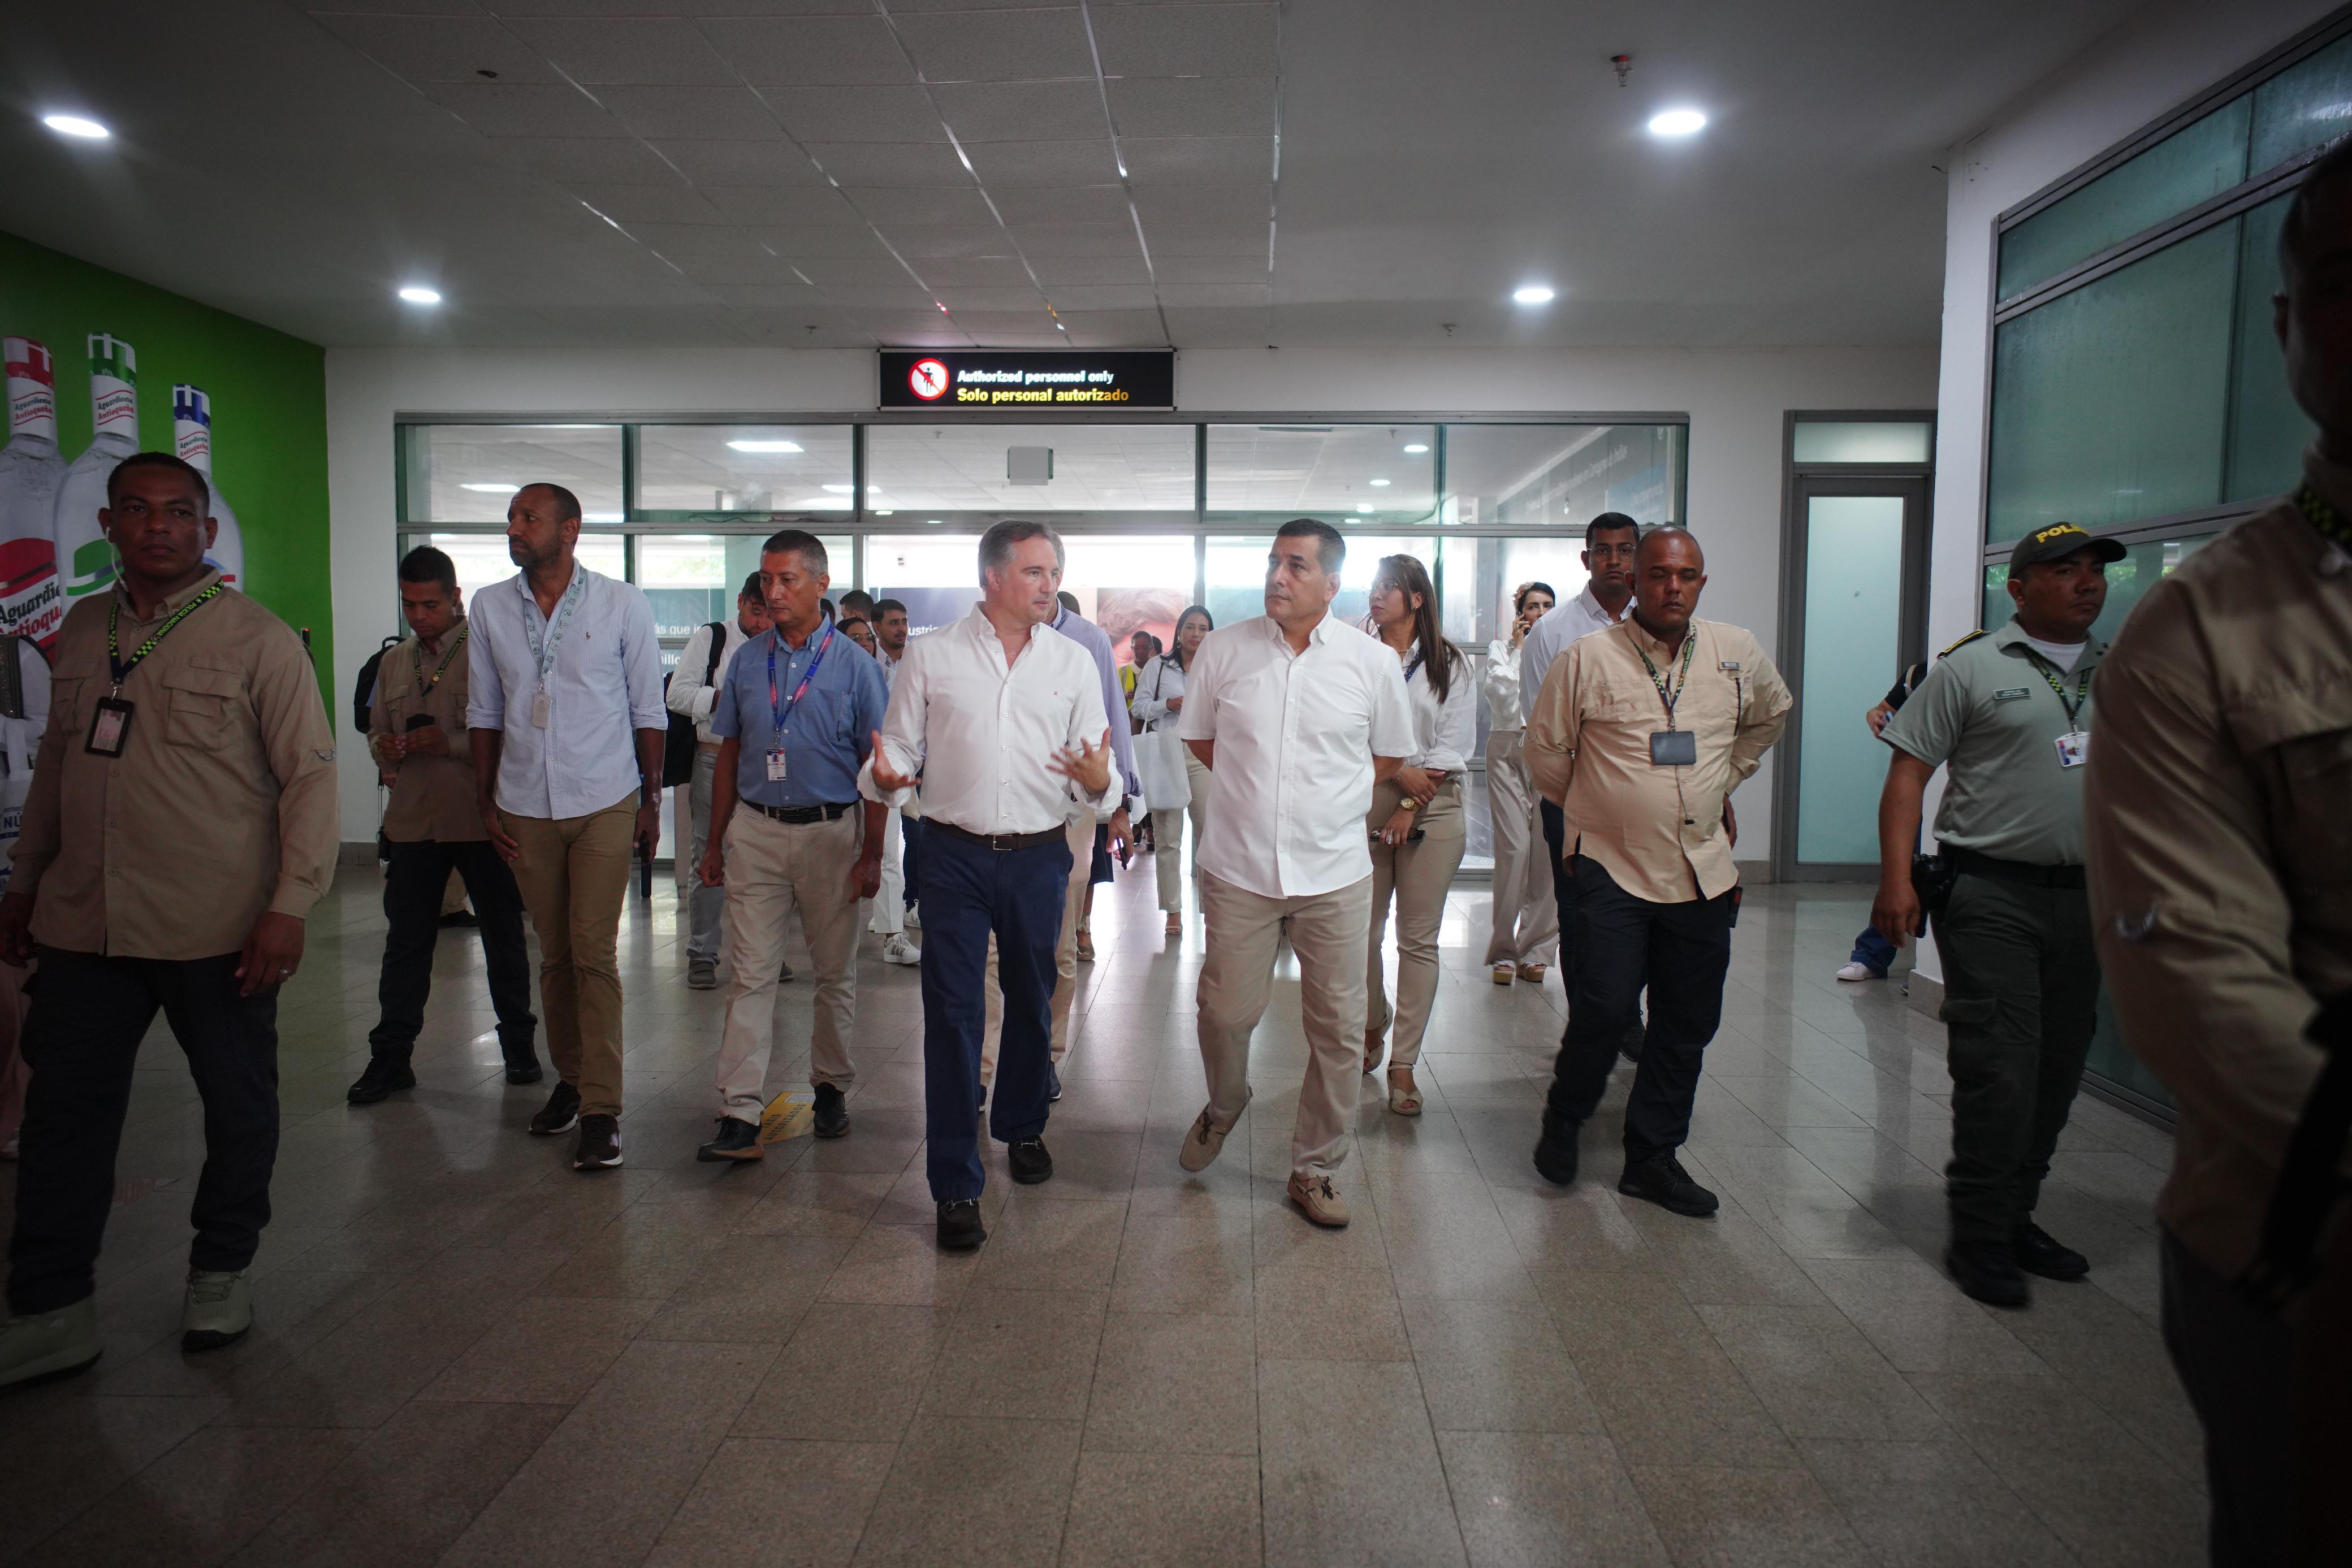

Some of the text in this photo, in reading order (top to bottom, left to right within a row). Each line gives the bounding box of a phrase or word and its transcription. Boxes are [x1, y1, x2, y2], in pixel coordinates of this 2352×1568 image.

[957, 370, 1114, 385] Authorized personnel only
[98, 396, 133, 410] Aguardiente
[957, 388, 1129, 404] Solo personal autorizado
[15, 397, 51, 412] Aguardiente
[98, 404, 135, 421] Antioqueño
[15, 405, 53, 422] Antioqueño
[2035, 524, 2090, 544] POL
[156, 616, 180, 636] NACIONA
[669, 625, 690, 636] que
[764, 1104, 806, 1140] AUTORIZADOS
